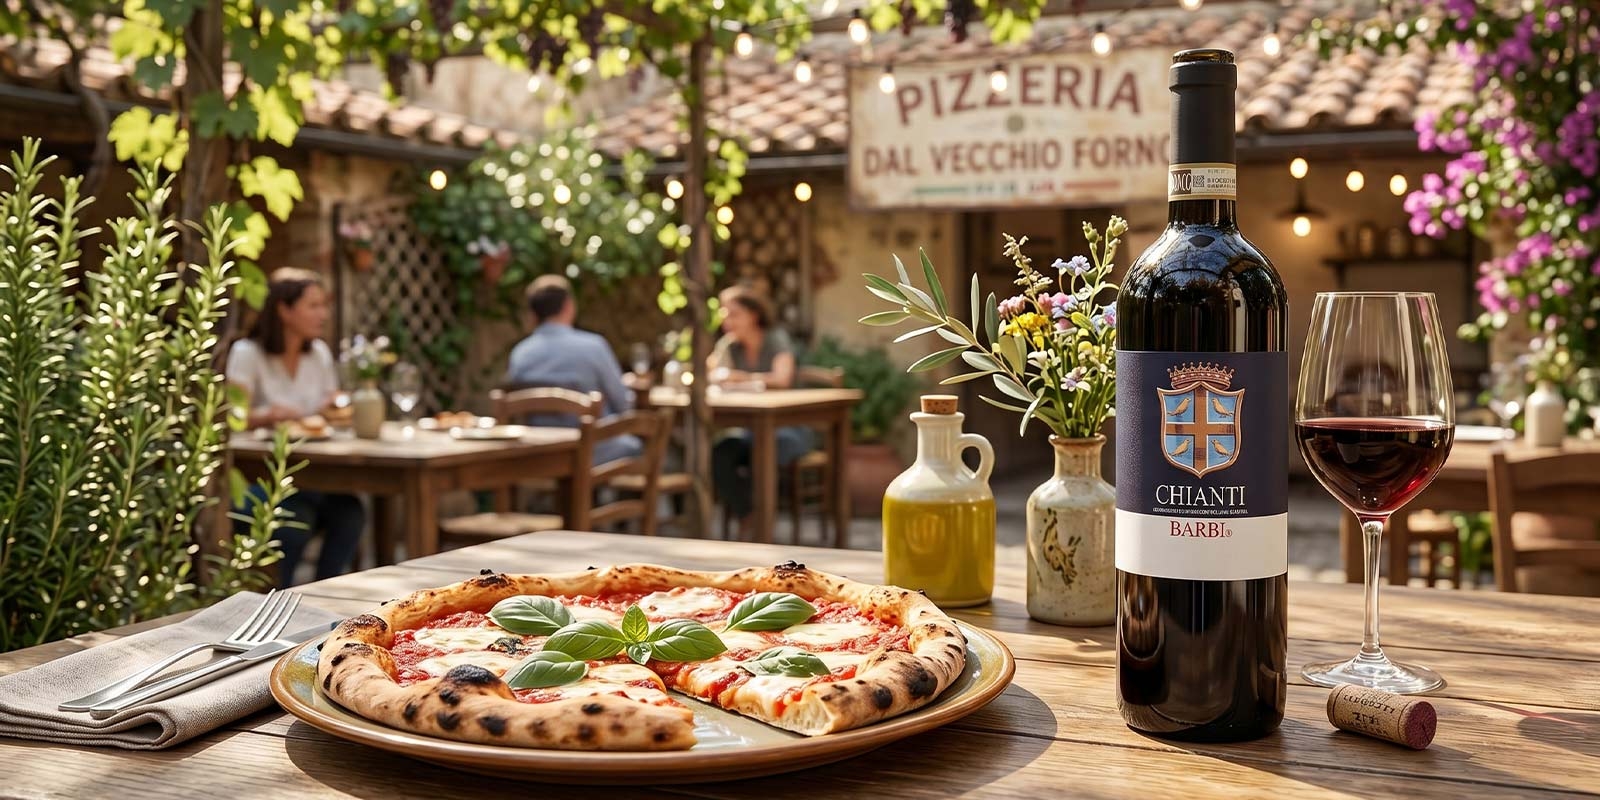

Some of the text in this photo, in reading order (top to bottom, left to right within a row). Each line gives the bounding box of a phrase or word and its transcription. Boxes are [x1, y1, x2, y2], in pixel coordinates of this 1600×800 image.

[895, 63, 1142, 125] PIZZERIA
[863, 145, 919, 177] DAL
[930, 138, 1062, 173] VECCHIO
[1155, 484, 1246, 507] CHIANTI
